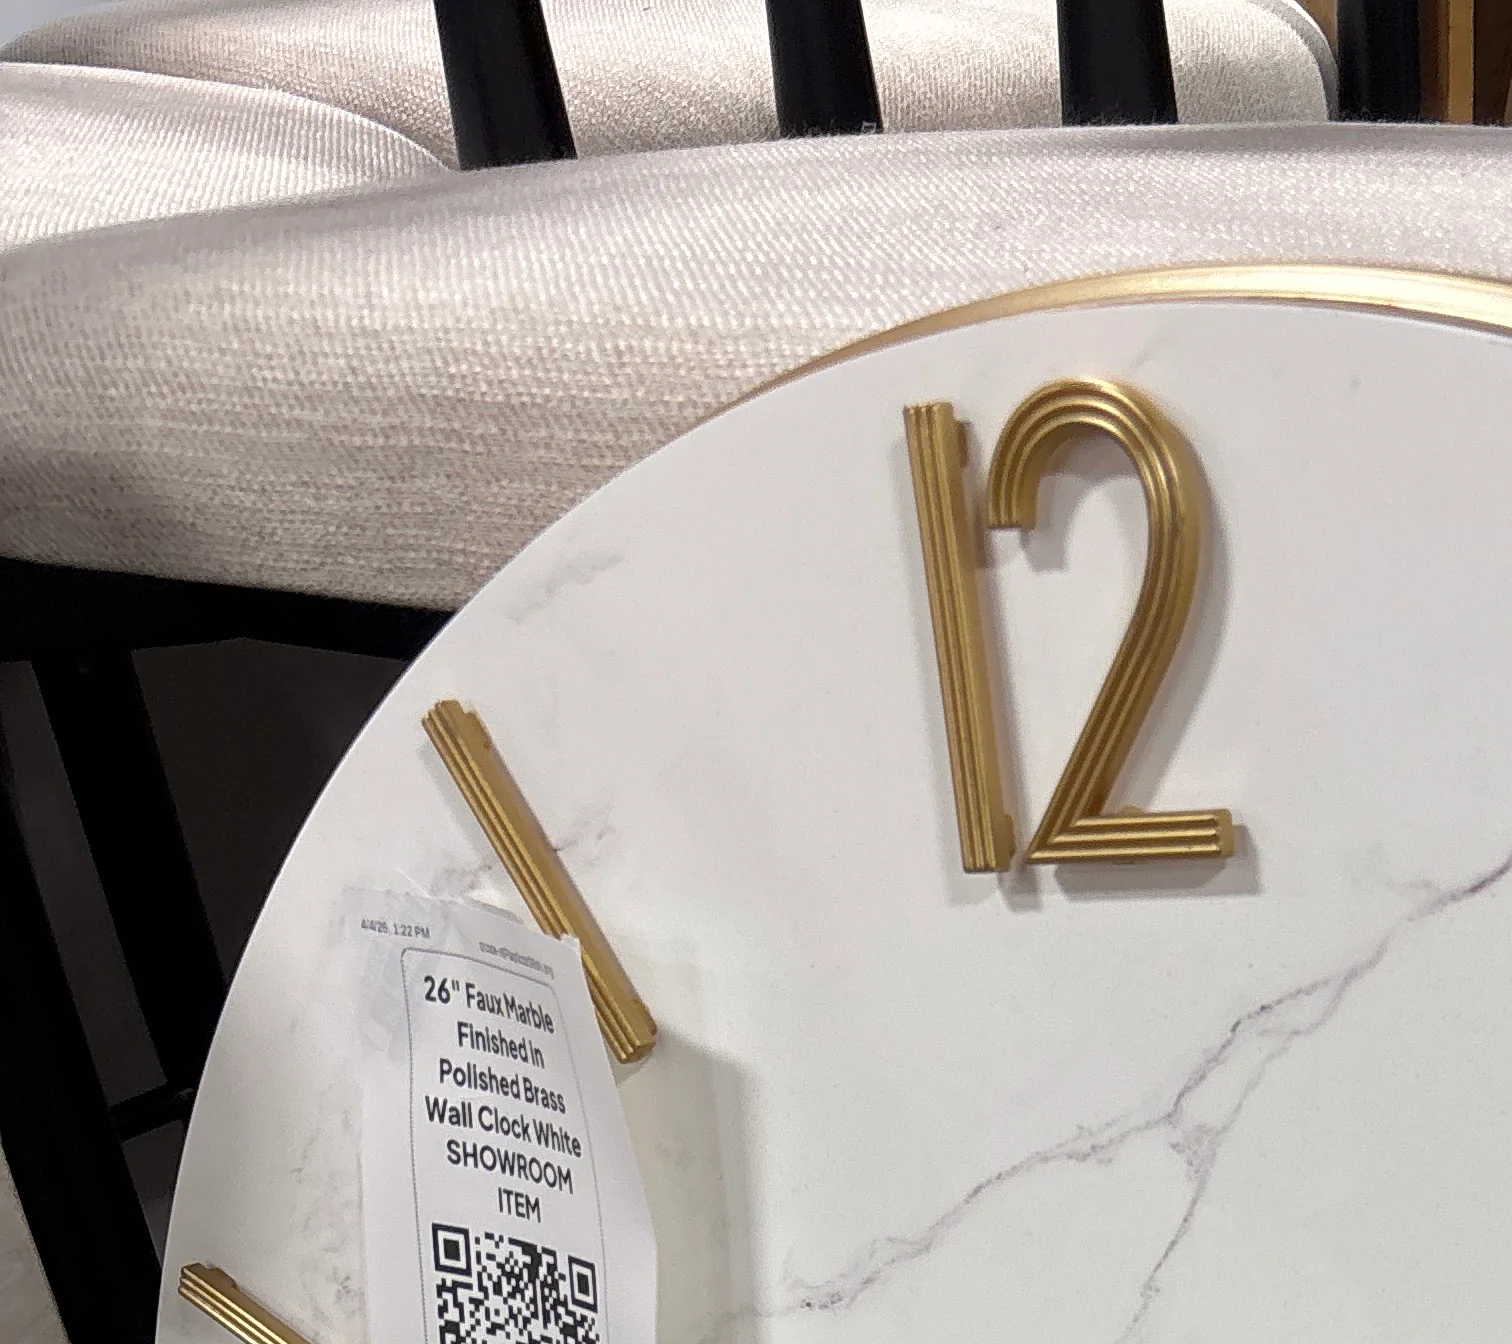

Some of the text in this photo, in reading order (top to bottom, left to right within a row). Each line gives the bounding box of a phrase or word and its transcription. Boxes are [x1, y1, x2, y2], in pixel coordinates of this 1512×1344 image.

[904, 378, 1235, 875] 12
[423, 975, 554, 1035] 26" Faux Marble
[457, 1021, 527, 1064] Finished
[439, 1058, 566, 1114] Polished Brass
[425, 1096, 581, 1158] Wall Clock White
[446, 1139, 573, 1194] SHOWROOM
[498, 1187, 541, 1223] ITEM
